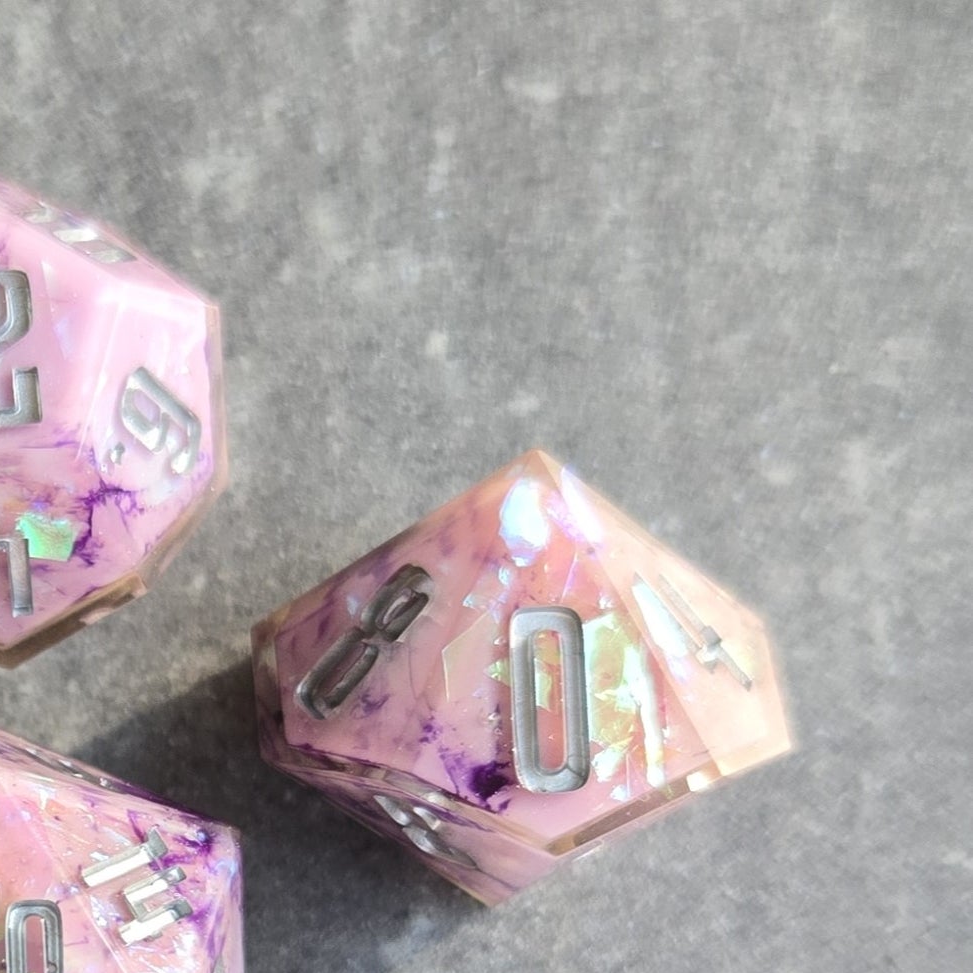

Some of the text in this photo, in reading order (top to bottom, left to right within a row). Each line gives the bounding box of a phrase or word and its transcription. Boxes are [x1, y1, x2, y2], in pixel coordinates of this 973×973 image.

[295, 562, 431, 720] 8
[509, 605, 591, 793] 0
[81, 826, 194, 946] 14
